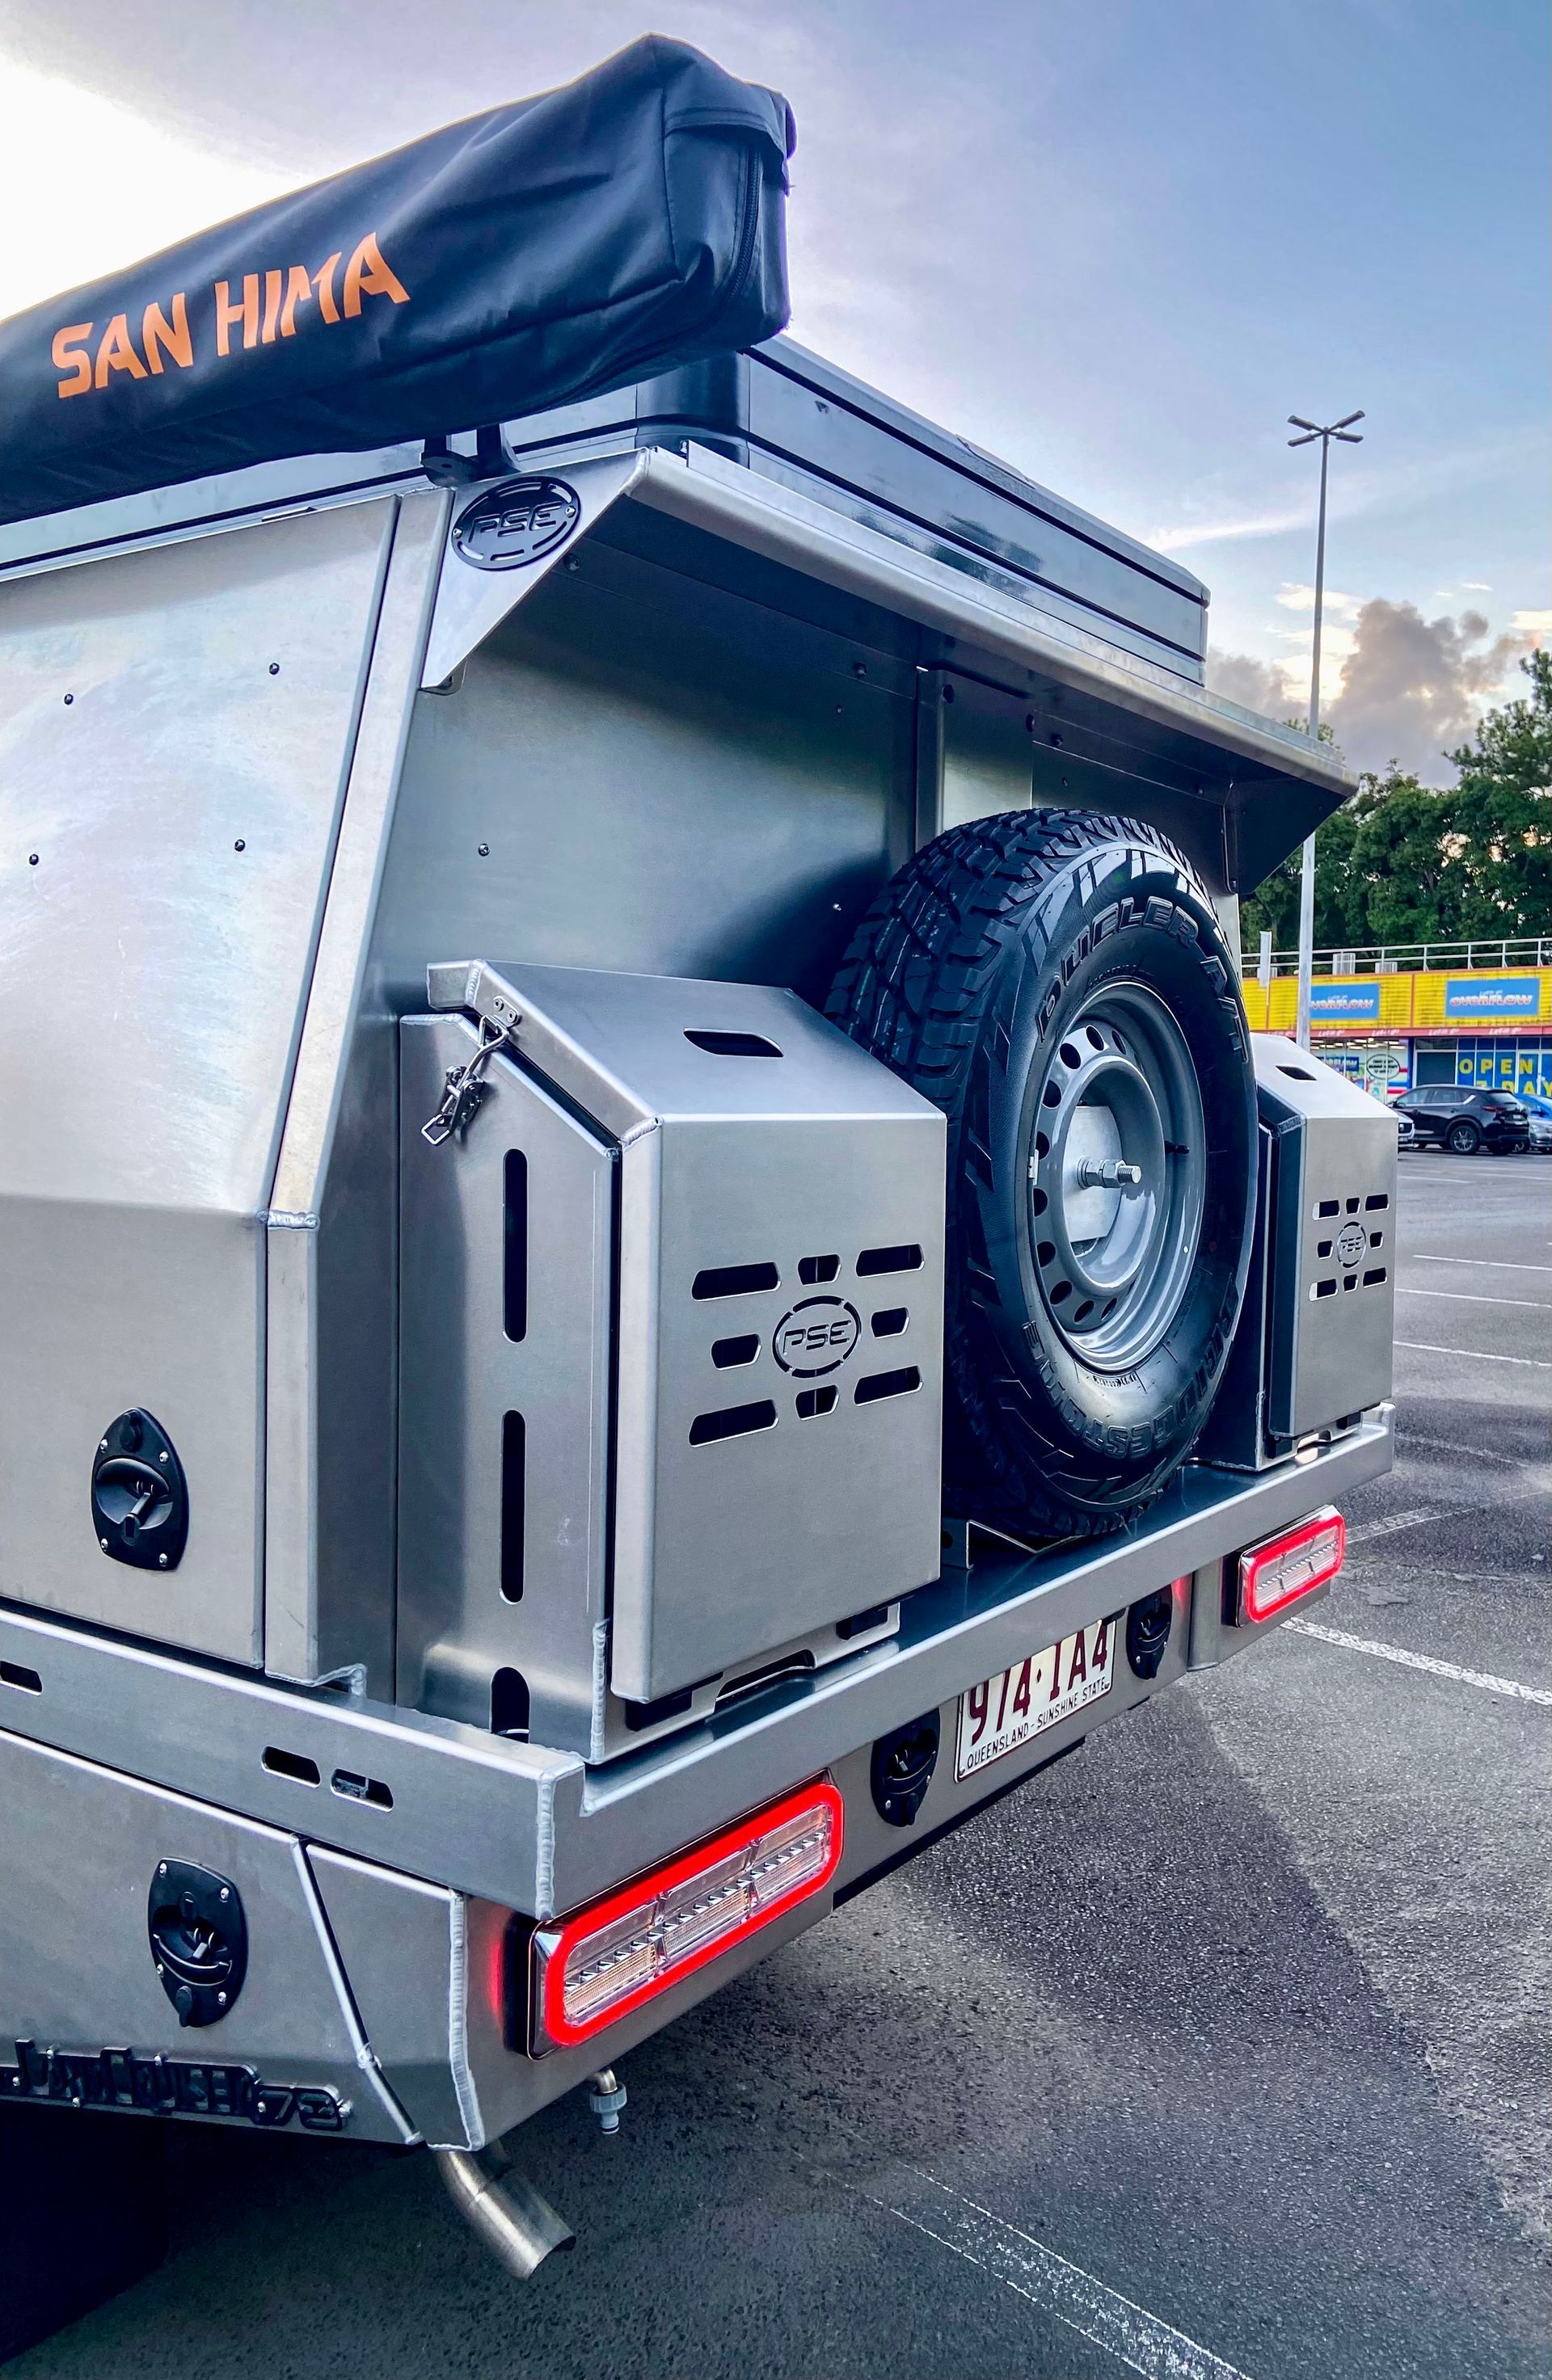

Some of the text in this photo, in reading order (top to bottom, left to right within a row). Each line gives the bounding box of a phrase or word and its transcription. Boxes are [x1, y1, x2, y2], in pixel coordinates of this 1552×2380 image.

[52, 232, 411, 398] SAN HIMA
[467, 501, 563, 543] PSE
[1035, 895, 1199, 1043] DUELER
[1310, 998, 1374, 1009] VERFLOW
[1449, 994, 1533, 1007] OVERFLOW
[1458, 1058, 1533, 1074] OPEN
[782, 1320, 851, 1354] PSE
[966, 1675, 1107, 1769] QUEENSLAND SUNSHINE STATE
